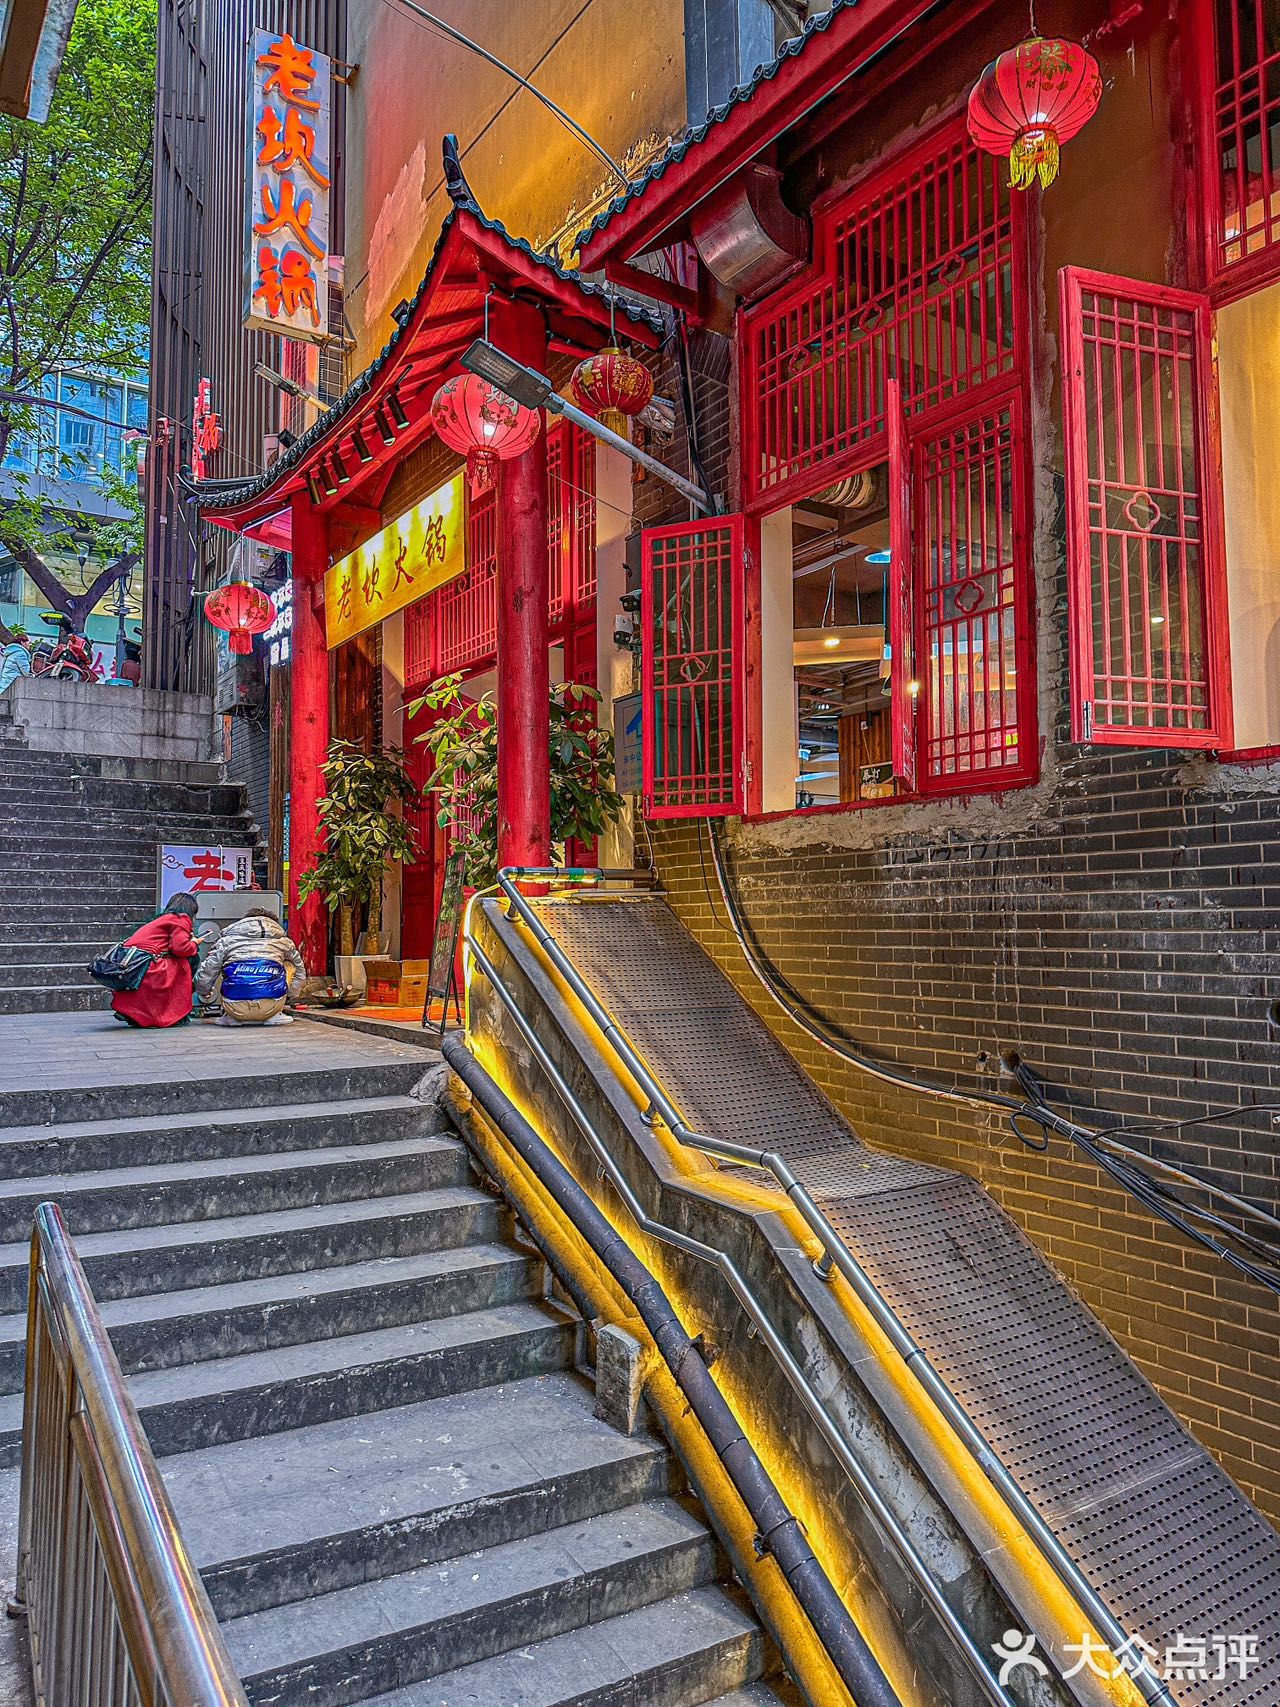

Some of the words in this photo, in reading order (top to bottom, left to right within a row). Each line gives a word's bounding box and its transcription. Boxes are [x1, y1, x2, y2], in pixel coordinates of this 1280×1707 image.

[254, 33, 331, 327] 老坎火锅
[337, 514, 446, 625] 老坎火锅
